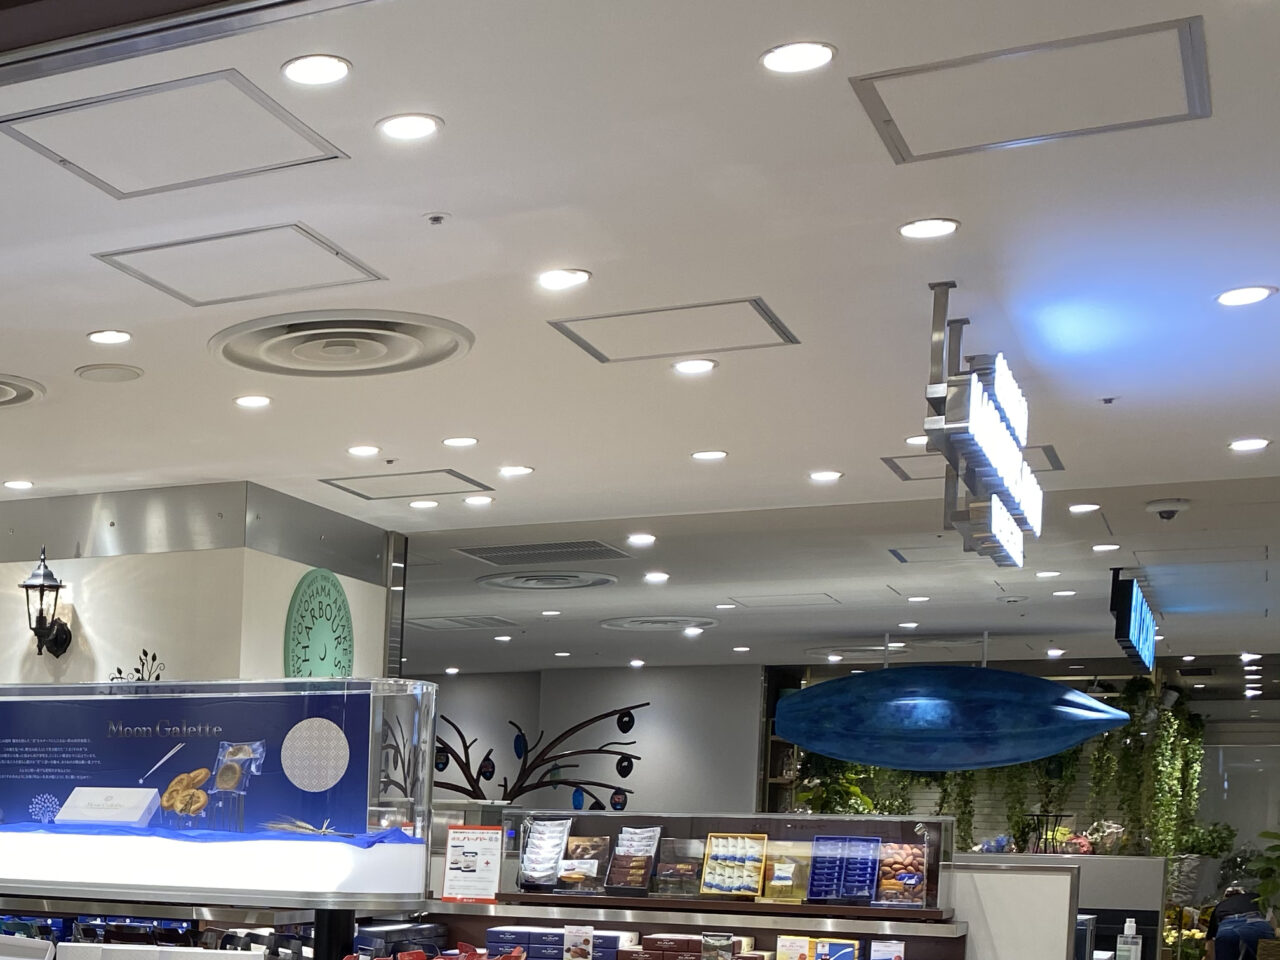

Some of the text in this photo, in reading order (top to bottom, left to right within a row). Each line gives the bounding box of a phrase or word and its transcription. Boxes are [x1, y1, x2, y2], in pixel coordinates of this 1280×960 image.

[295, 585, 348, 657] YOKOHAMA ARIAKE
[106, 719, 224, 739] Moon Galette
